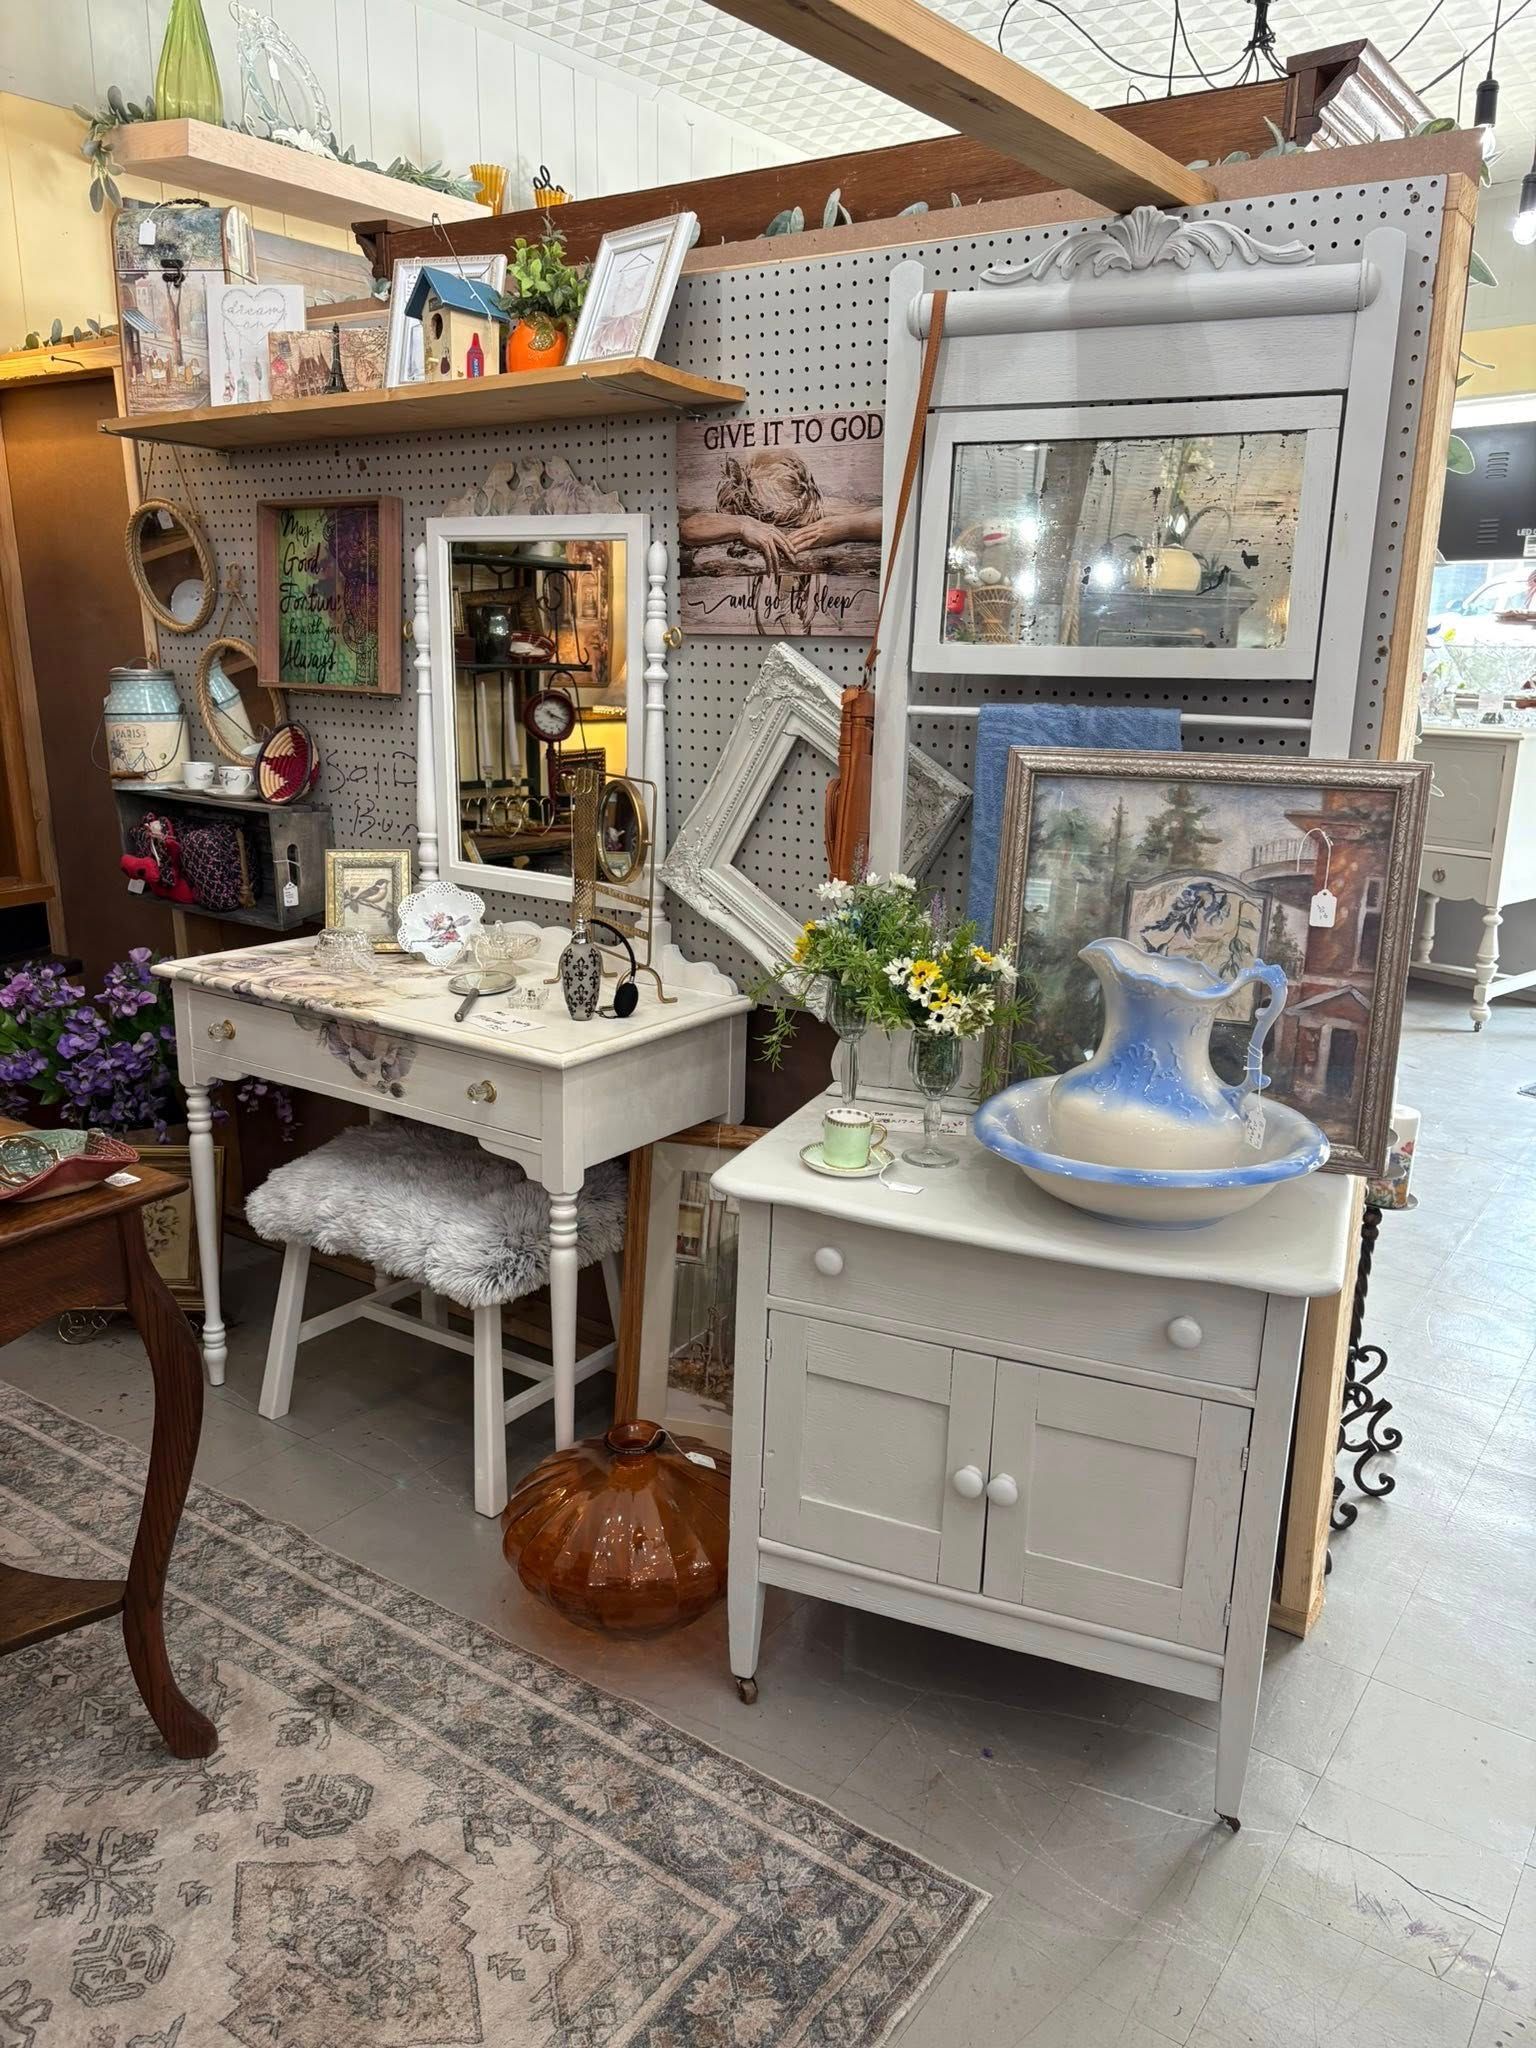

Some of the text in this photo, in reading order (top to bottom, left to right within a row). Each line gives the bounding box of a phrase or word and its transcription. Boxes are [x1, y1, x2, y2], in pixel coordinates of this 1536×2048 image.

[226, 300, 284, 316] dream
[704, 413, 884, 450] GIVE IT TO GOD
[281, 510, 311, 544] May
[283, 542, 321, 576] Good
[729, 585, 855, 619] and go to sleep
[289, 618, 299, 635] be
[282, 640, 337, 684] Always
[115, 728, 142, 739] PARIS
